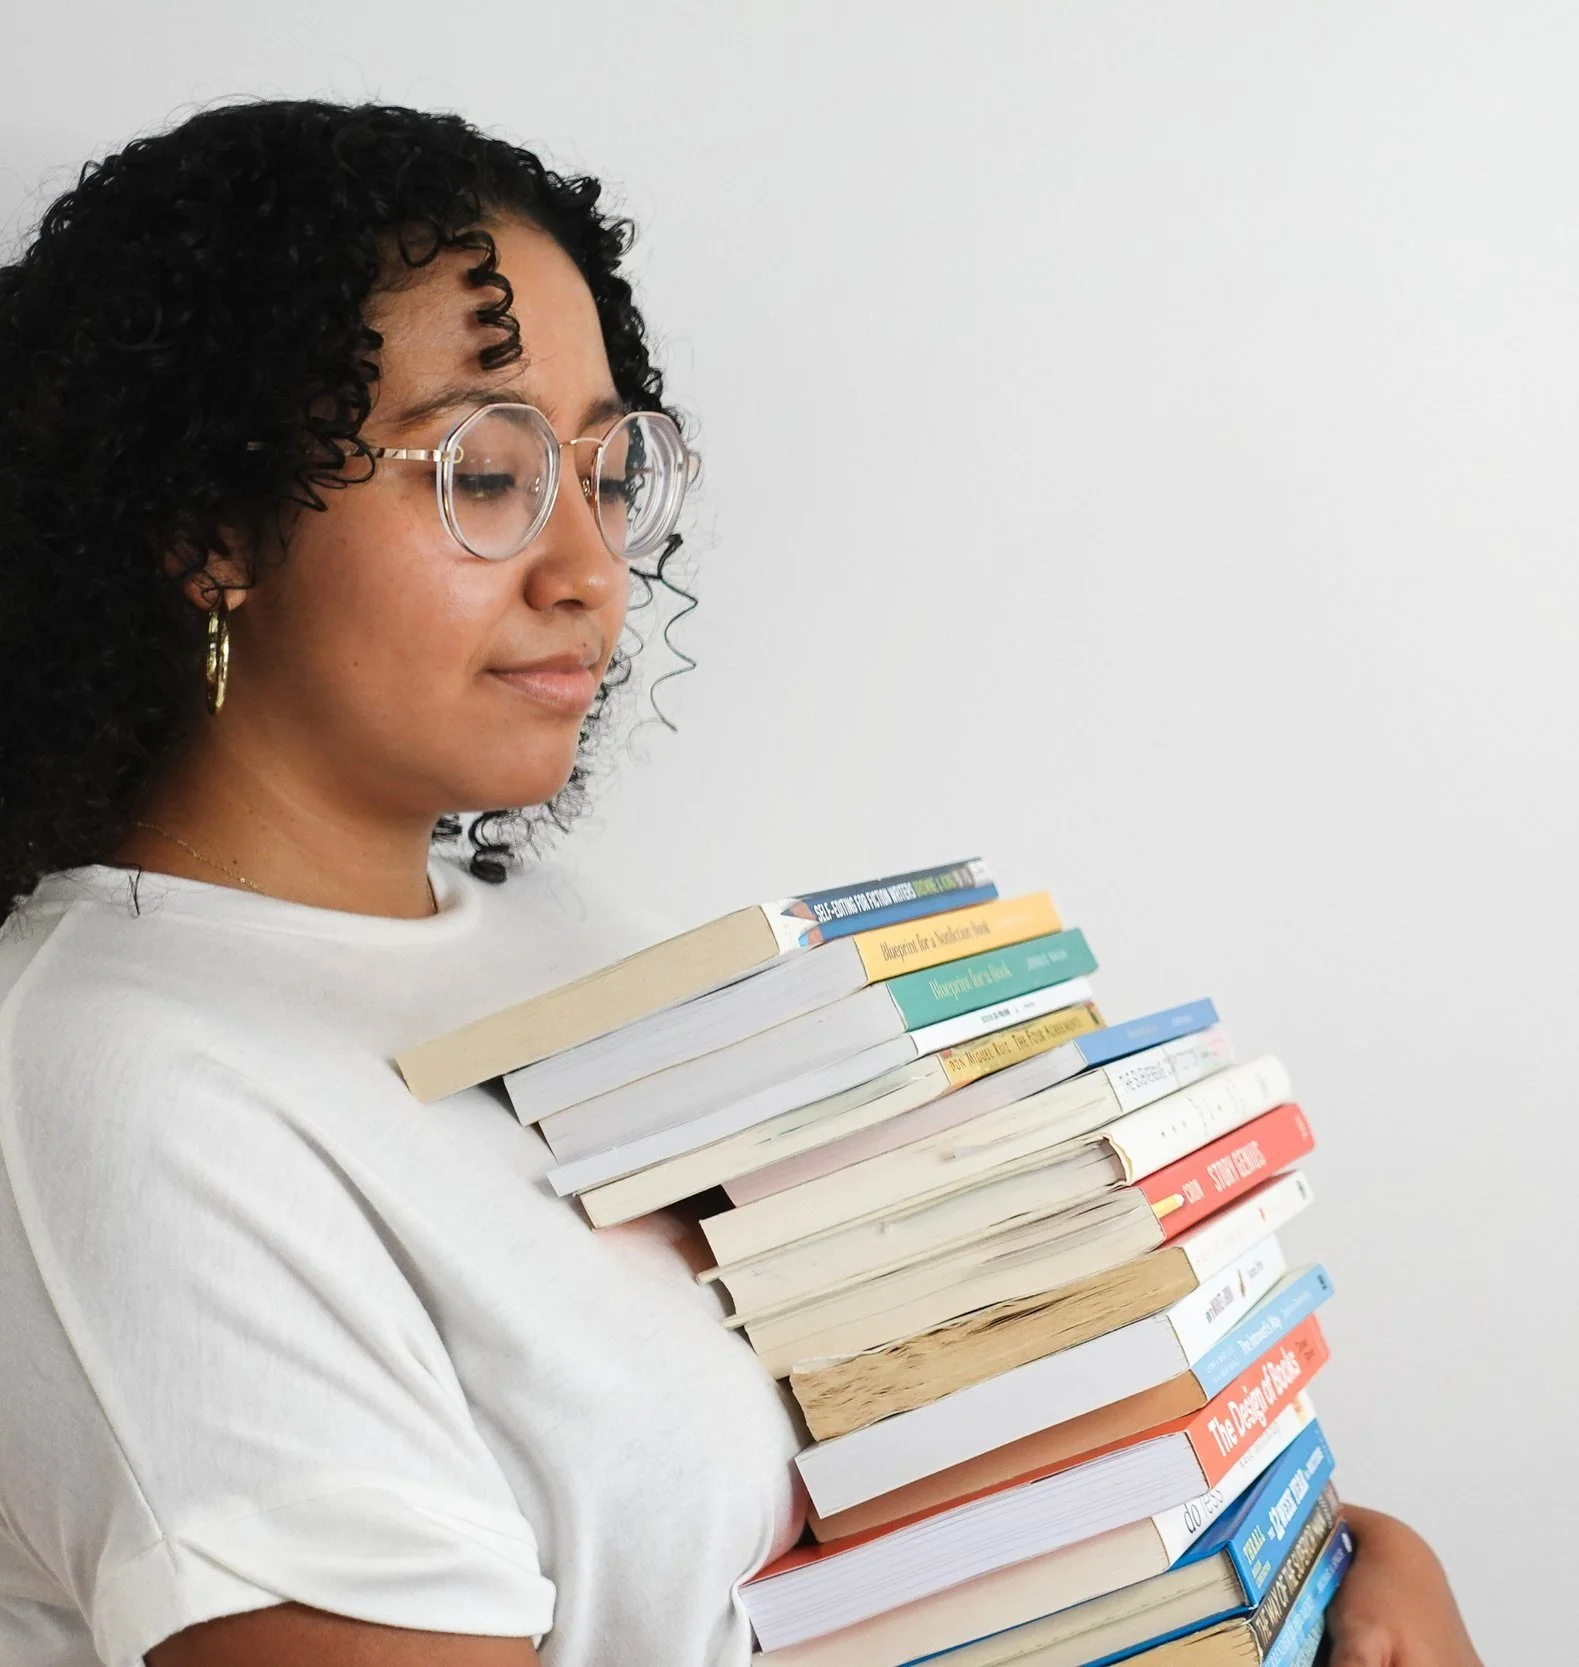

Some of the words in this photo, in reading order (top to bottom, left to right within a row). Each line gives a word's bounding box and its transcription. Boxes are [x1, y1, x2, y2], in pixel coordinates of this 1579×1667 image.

[814, 897, 858, 922] SELF-EDITING
[854, 893, 870, 912] FOR
[868, 888, 893, 910] FICTION
[888, 881, 917, 904] WRITERS
[879, 938, 918, 962] Blueprint
[916, 931, 930, 950] for
[929, 936, 938, 949] a
[934, 922, 973, 947] Nonfiction
[929, 974, 971, 1001] Blueprint
[968, 968, 984, 987] for
[987, 960, 1013, 982] Book
[1182, 1178, 1205, 1204] CRON
[1206, 1153, 1240, 1192] STORY
[1231, 1140, 1267, 1178] GENIUS
[1260, 1364, 1277, 1405] of
[1266, 1345, 1302, 1396] Books
[1228, 1386, 1268, 1437] Design
[1207, 1413, 1238, 1457] The
[1183, 1503, 1201, 1534] do
[1200, 1488, 1224, 1519] less
[1255, 1608, 1273, 1644] THE
[1264, 1585, 1284, 1628] WAY
[1275, 1574, 1289, 1608] OF
